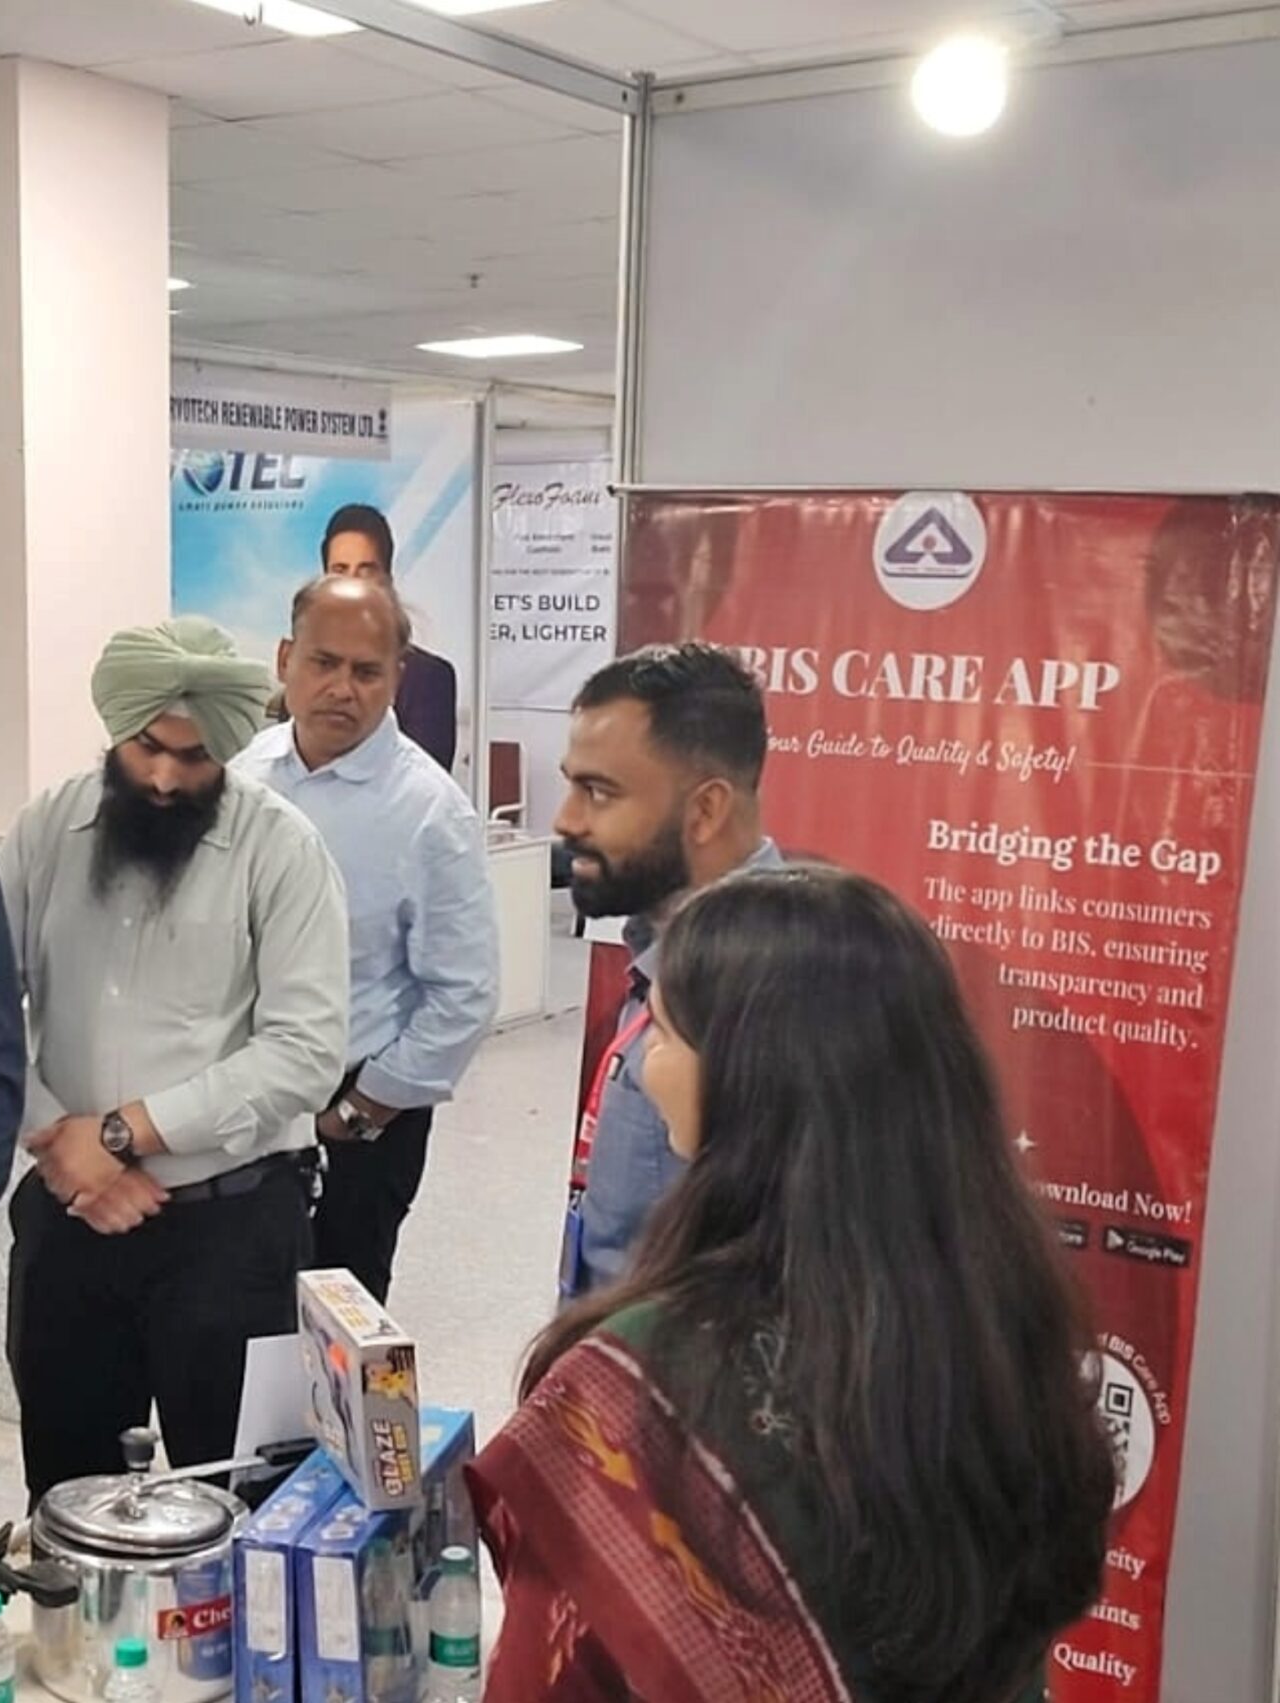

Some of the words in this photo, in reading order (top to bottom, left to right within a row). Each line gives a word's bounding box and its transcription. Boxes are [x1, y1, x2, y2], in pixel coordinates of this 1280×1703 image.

[222, 401, 281, 431] RENEWABLE
[284, 406, 318, 433] POWER
[321, 410, 355, 435] SYSTEM
[538, 594, 600, 611] BUILD
[522, 624, 607, 641] LIGHTER
[832, 649, 984, 702] CARE
[994, 657, 1120, 711] APP
[806, 728, 867, 758] Guide
[869, 736, 892, 757] to
[896, 735, 972, 775] Quality
[975, 741, 993, 765] &
[996, 741, 1075, 784] Safety!
[927, 819, 1077, 871] Bridging
[1084, 833, 1141, 867] the
[1151, 838, 1222, 884] Gap
[923, 876, 967, 902] The
[971, 887, 1013, 911] app
[1020, 884, 1077, 914] links
[1083, 898, 1212, 930] consumers
[1021, 926, 1044, 949] to
[1103, 939, 1209, 973] ensuring
[999, 962, 1152, 1006] transparency
[1156, 983, 1204, 1009] and
[1011, 1005, 1106, 1036] product
[1112, 1018, 1198, 1051] quality.
[1133, 1192, 1192, 1224] Now!
[1151, 1391, 1172, 1425] App
[1053, 1642, 1137, 1687] Quality
